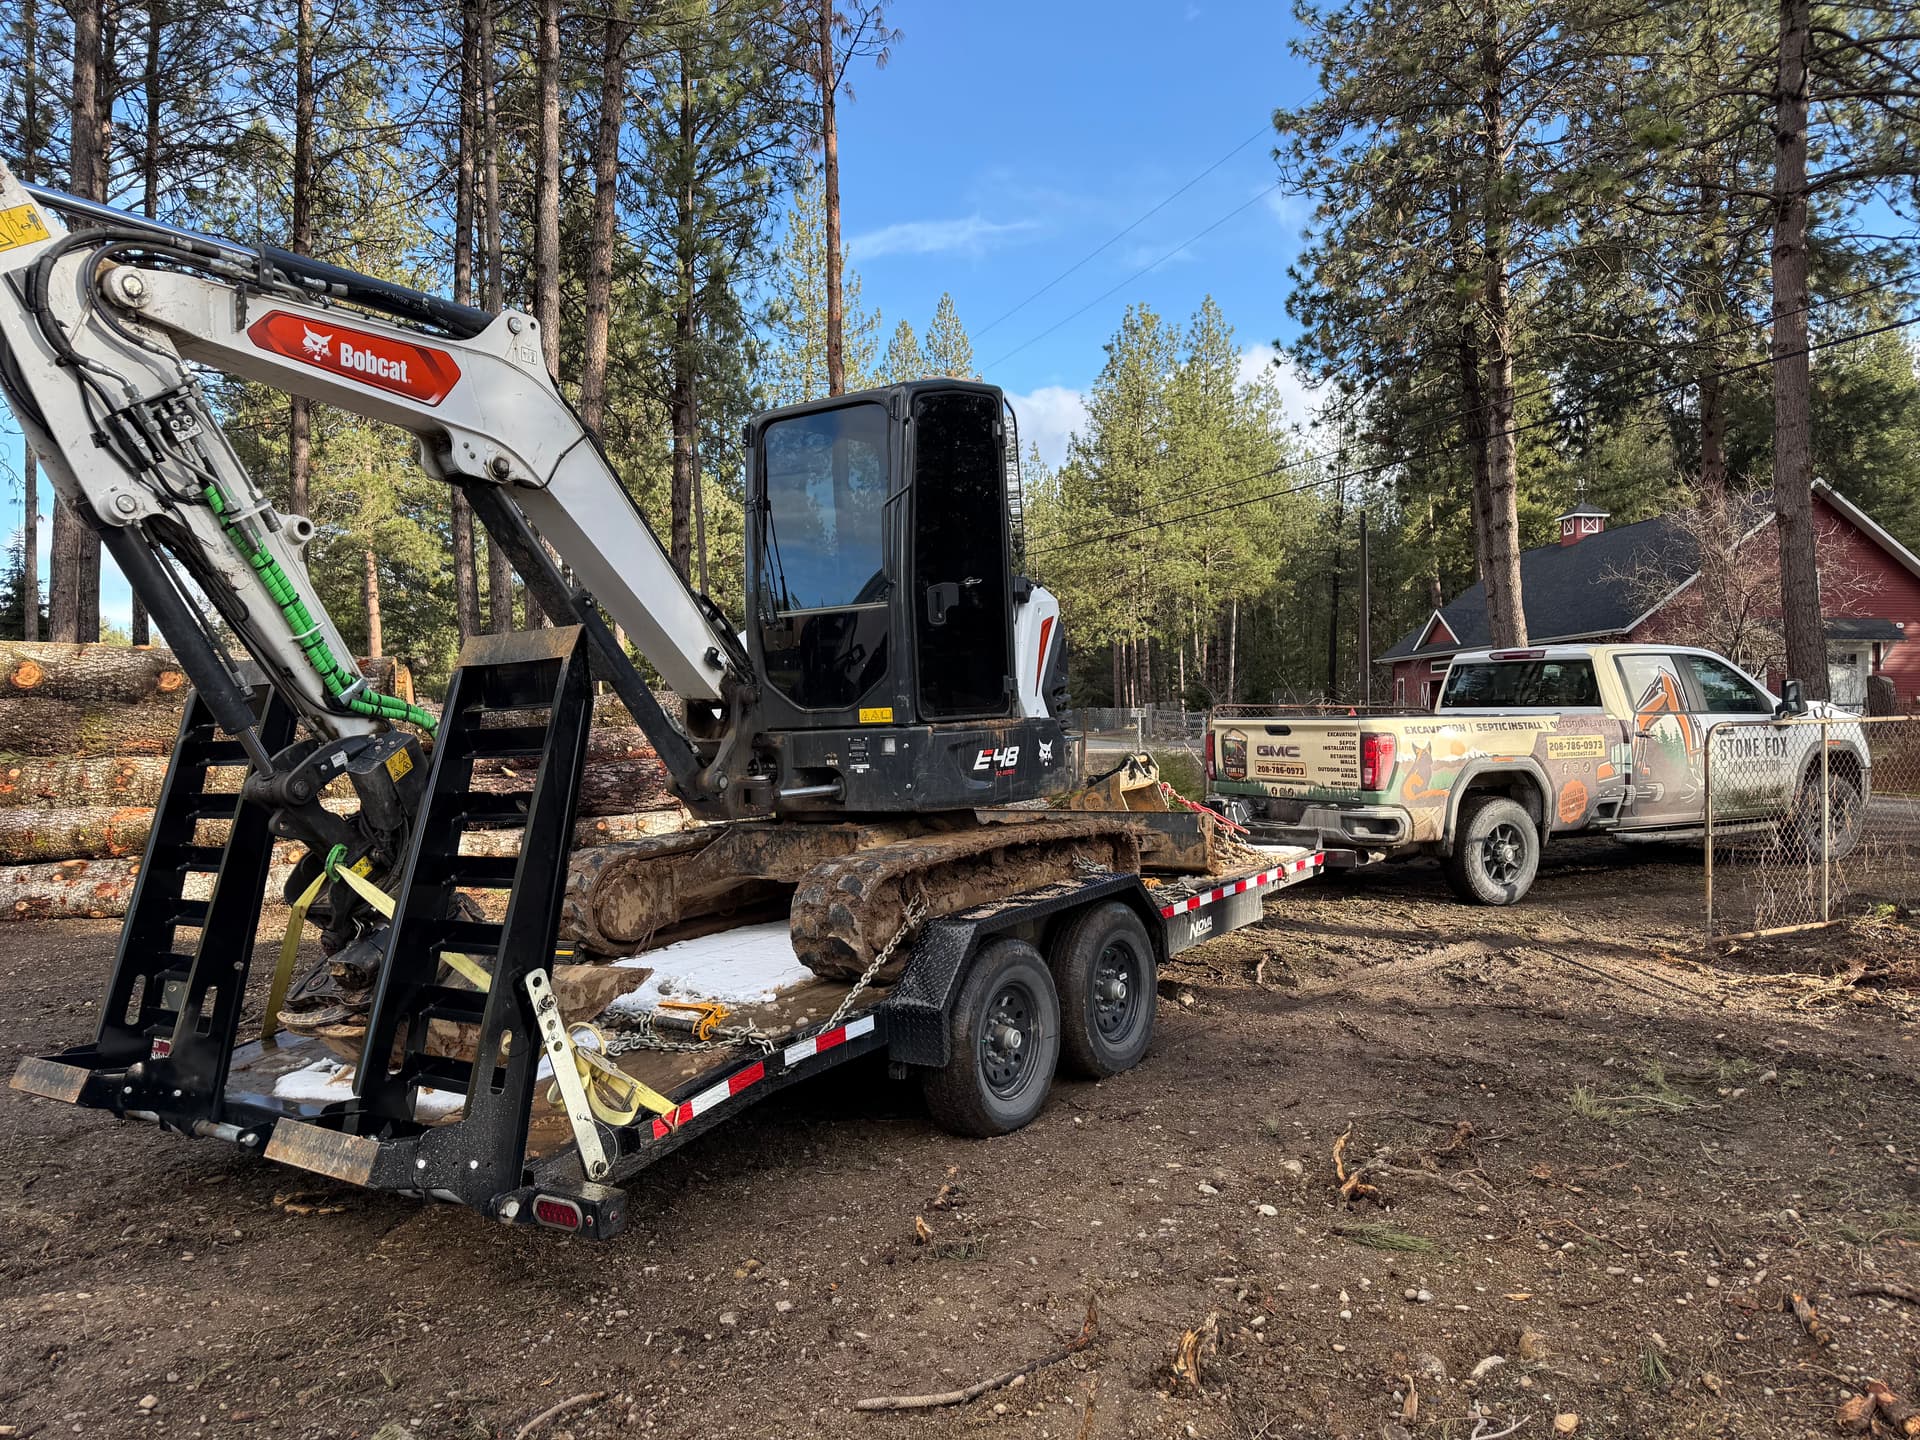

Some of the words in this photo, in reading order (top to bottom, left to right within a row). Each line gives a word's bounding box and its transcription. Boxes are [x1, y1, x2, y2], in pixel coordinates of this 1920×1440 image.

[340, 342, 408, 383] Bobcat
[1404, 723, 1467, 734] EXCAVAION
[1256, 745, 1301, 757] GMC
[1549, 740, 1603, 751] 208-786-0973
[1720, 738, 1760, 760] STONE
[1765, 736, 1788, 757] FOX
[973, 746, 1020, 770] E48
[1257, 765, 1305, 775] 208-786-0973
[1190, 916, 1213, 940] NOVA
